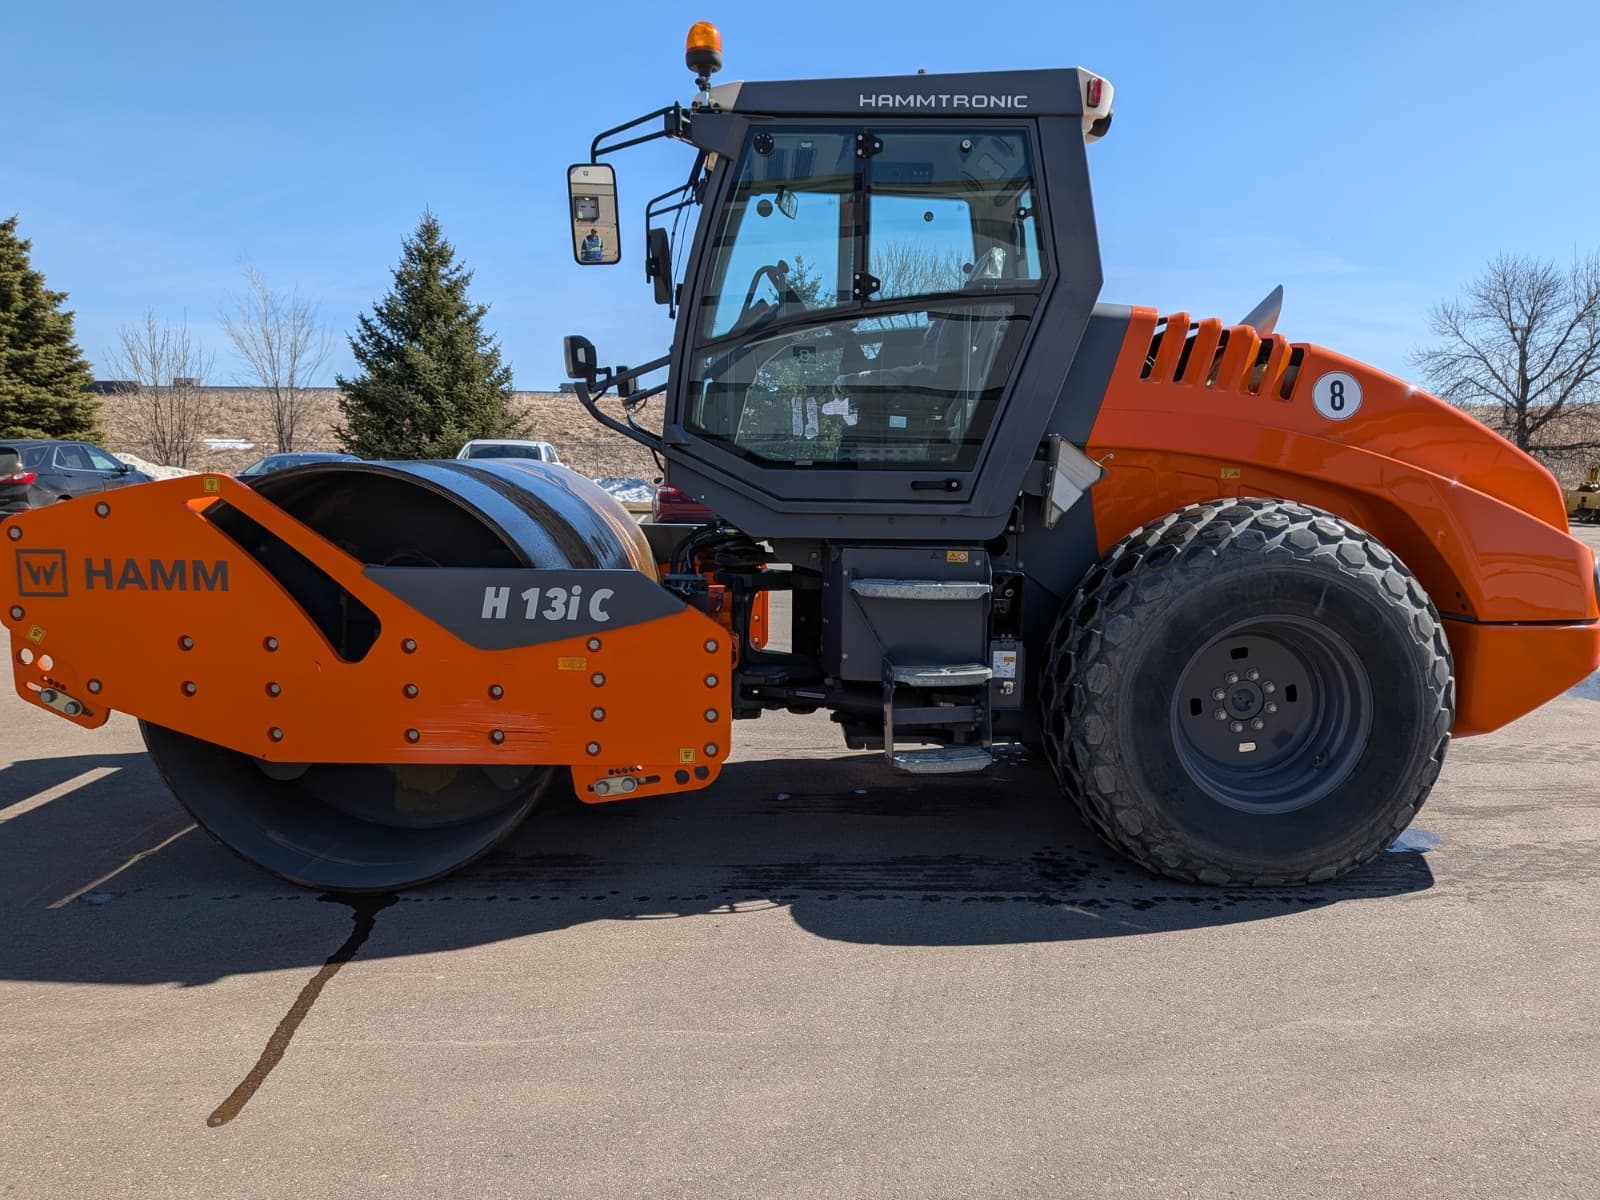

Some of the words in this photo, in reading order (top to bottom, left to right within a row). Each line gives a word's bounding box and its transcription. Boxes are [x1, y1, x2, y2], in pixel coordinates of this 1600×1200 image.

[859, 94, 1029, 109] HAMMTRONIC
[1330, 380, 1345, 411] 8
[84, 557, 230, 592] HAMM
[480, 586, 511, 620] H
[520, 584, 583, 622] 13i
[588, 588, 615, 623] C
